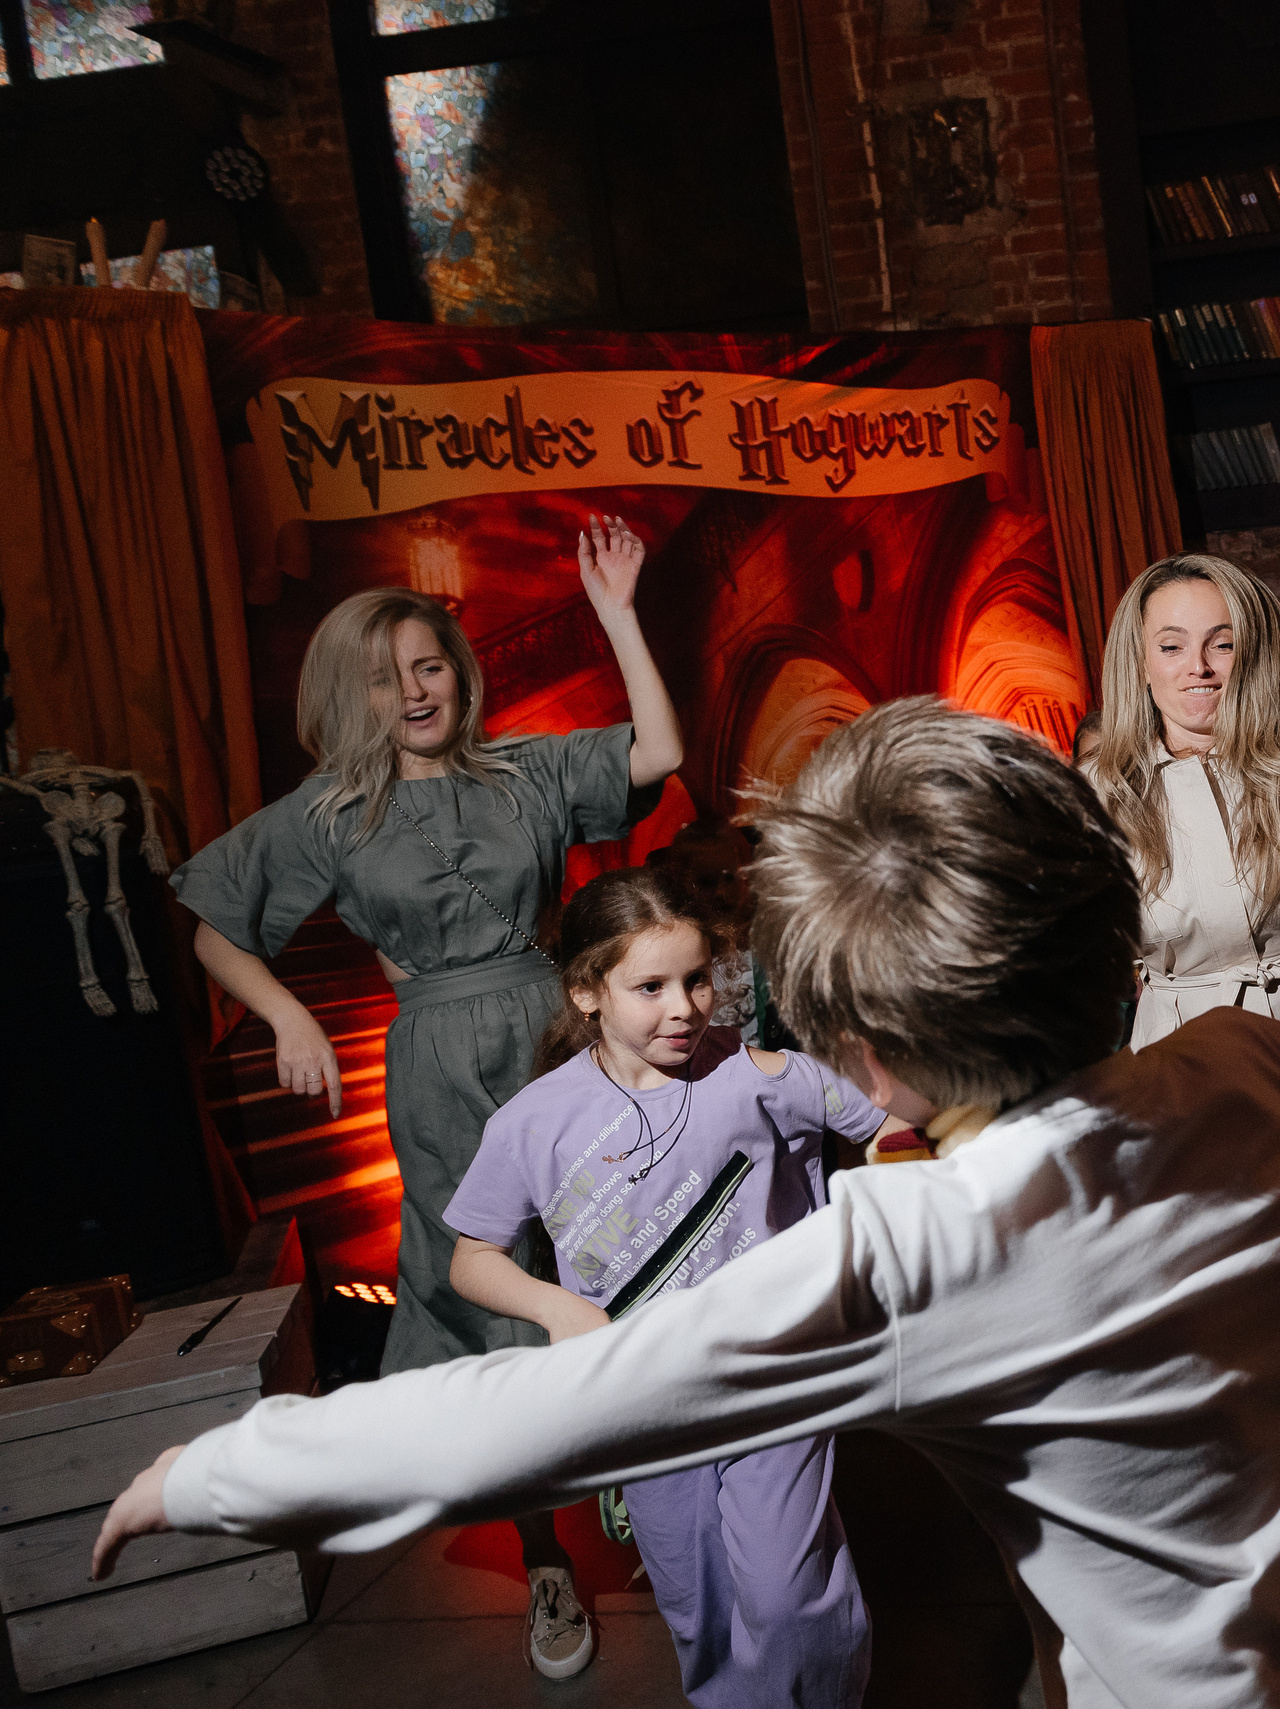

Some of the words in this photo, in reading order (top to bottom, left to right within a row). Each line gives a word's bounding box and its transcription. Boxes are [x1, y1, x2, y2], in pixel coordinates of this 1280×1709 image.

[275, 385, 597, 512] Miracles
[626, 380, 704, 470] of
[728, 388, 999, 493] Hogwarts
[583, 1139, 600, 1158] and
[598, 1104, 634, 1142] dilligence
[581, 1216, 603, 1238] Vitality
[600, 1194, 624, 1218] doing
[591, 1170, 623, 1202] Shows
[630, 1219, 658, 1249] and
[654, 1170, 701, 1221] Speed
[571, 1206, 640, 1283] ACTIVE
[626, 1242, 658, 1276] Laziness
[656, 1235, 664, 1246] or
[663, 1211, 686, 1237] Loose
[689, 1202, 741, 1263] Person.
